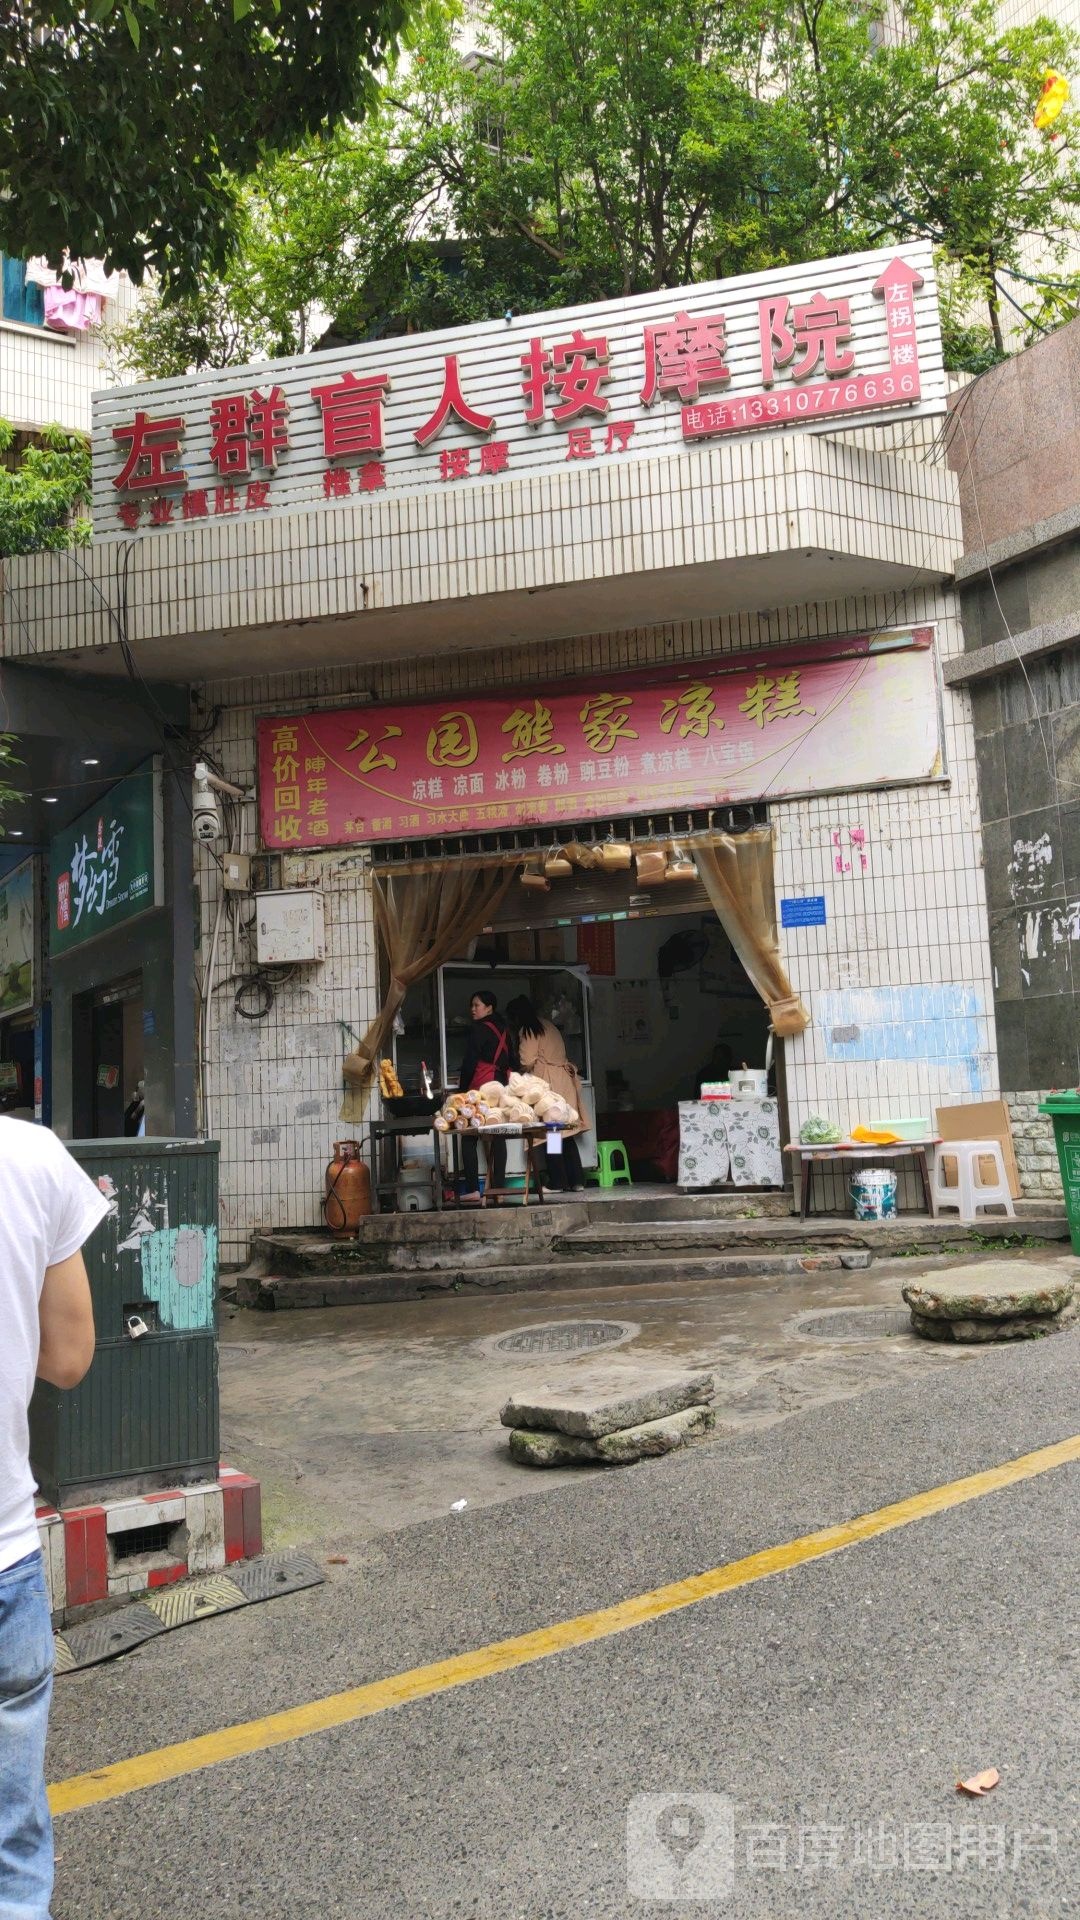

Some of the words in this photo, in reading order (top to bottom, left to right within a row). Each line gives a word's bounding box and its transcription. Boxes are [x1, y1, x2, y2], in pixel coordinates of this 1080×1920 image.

[887, 282, 915, 366] 左拐一楼
[111, 291, 857, 493] 左群盲人按摩院
[323, 460, 387, 499] 推拿
[439, 441, 510, 482] 按摩
[565, 421, 636, 462] 足疗
[271, 725, 302, 842] 高价回收
[412, 776, 444, 801] 凉糕
[453, 772, 484, 797] 凉面
[495, 767, 527, 792] 冰粉
